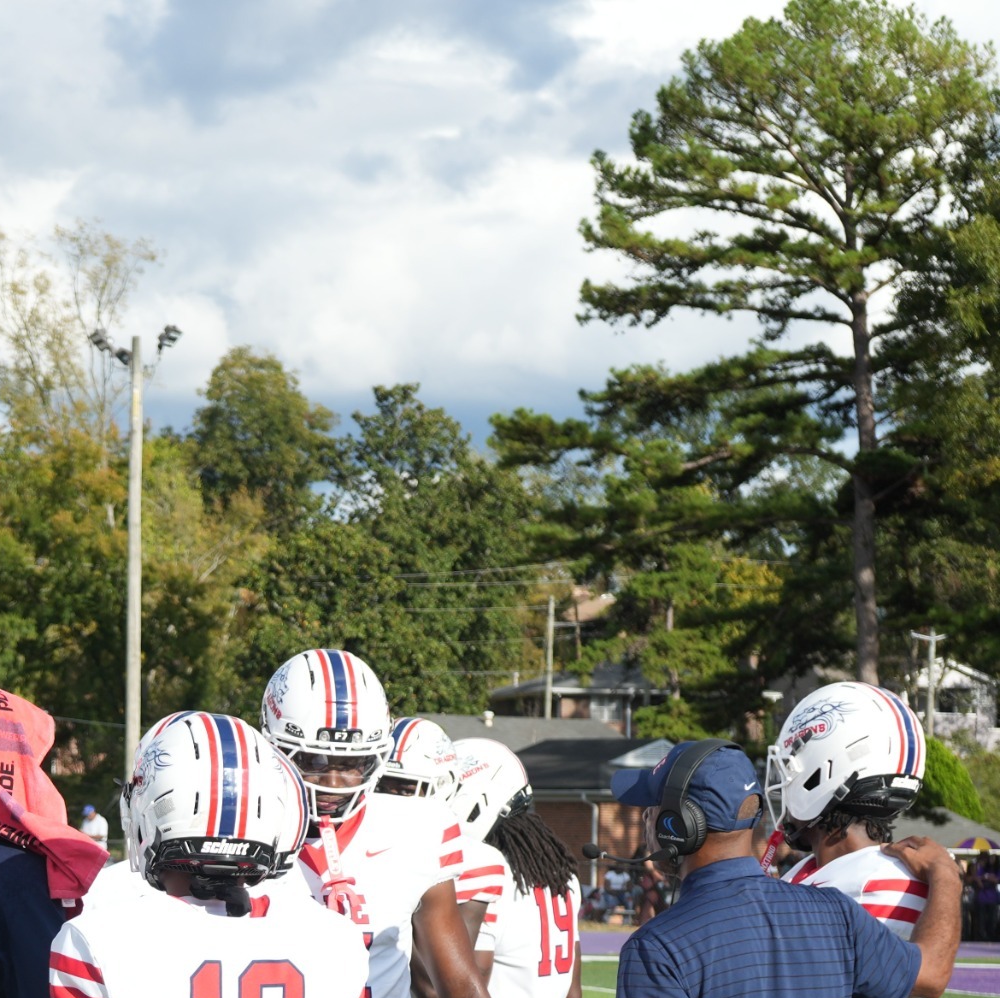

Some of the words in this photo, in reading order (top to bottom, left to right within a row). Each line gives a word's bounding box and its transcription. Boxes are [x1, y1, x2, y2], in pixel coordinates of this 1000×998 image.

[334, 731, 348, 741] F7
[200, 839, 250, 856] schutt
[533, 885, 573, 977] 19
